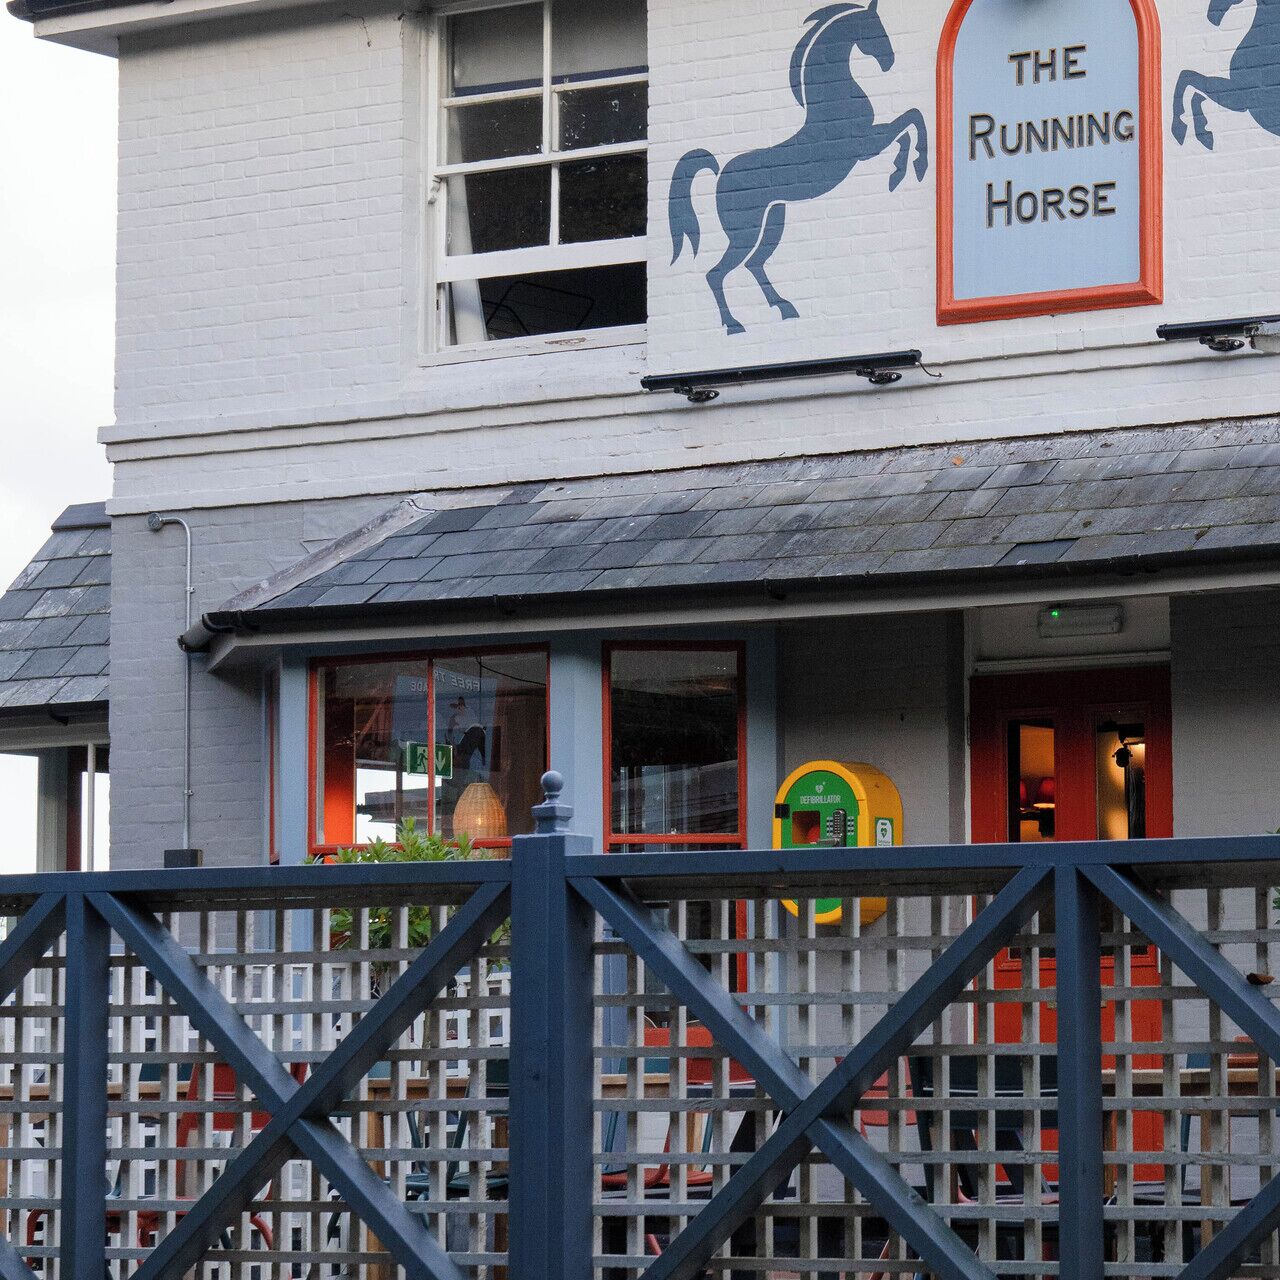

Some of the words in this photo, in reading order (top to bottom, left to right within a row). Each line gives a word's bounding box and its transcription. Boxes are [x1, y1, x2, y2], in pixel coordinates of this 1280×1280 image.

[1007, 43, 1088, 87] THE
[968, 109, 1136, 162] RUNNING
[985, 179, 1117, 229] HORSE
[799, 794, 841, 805] DEFIBRILLATOR
